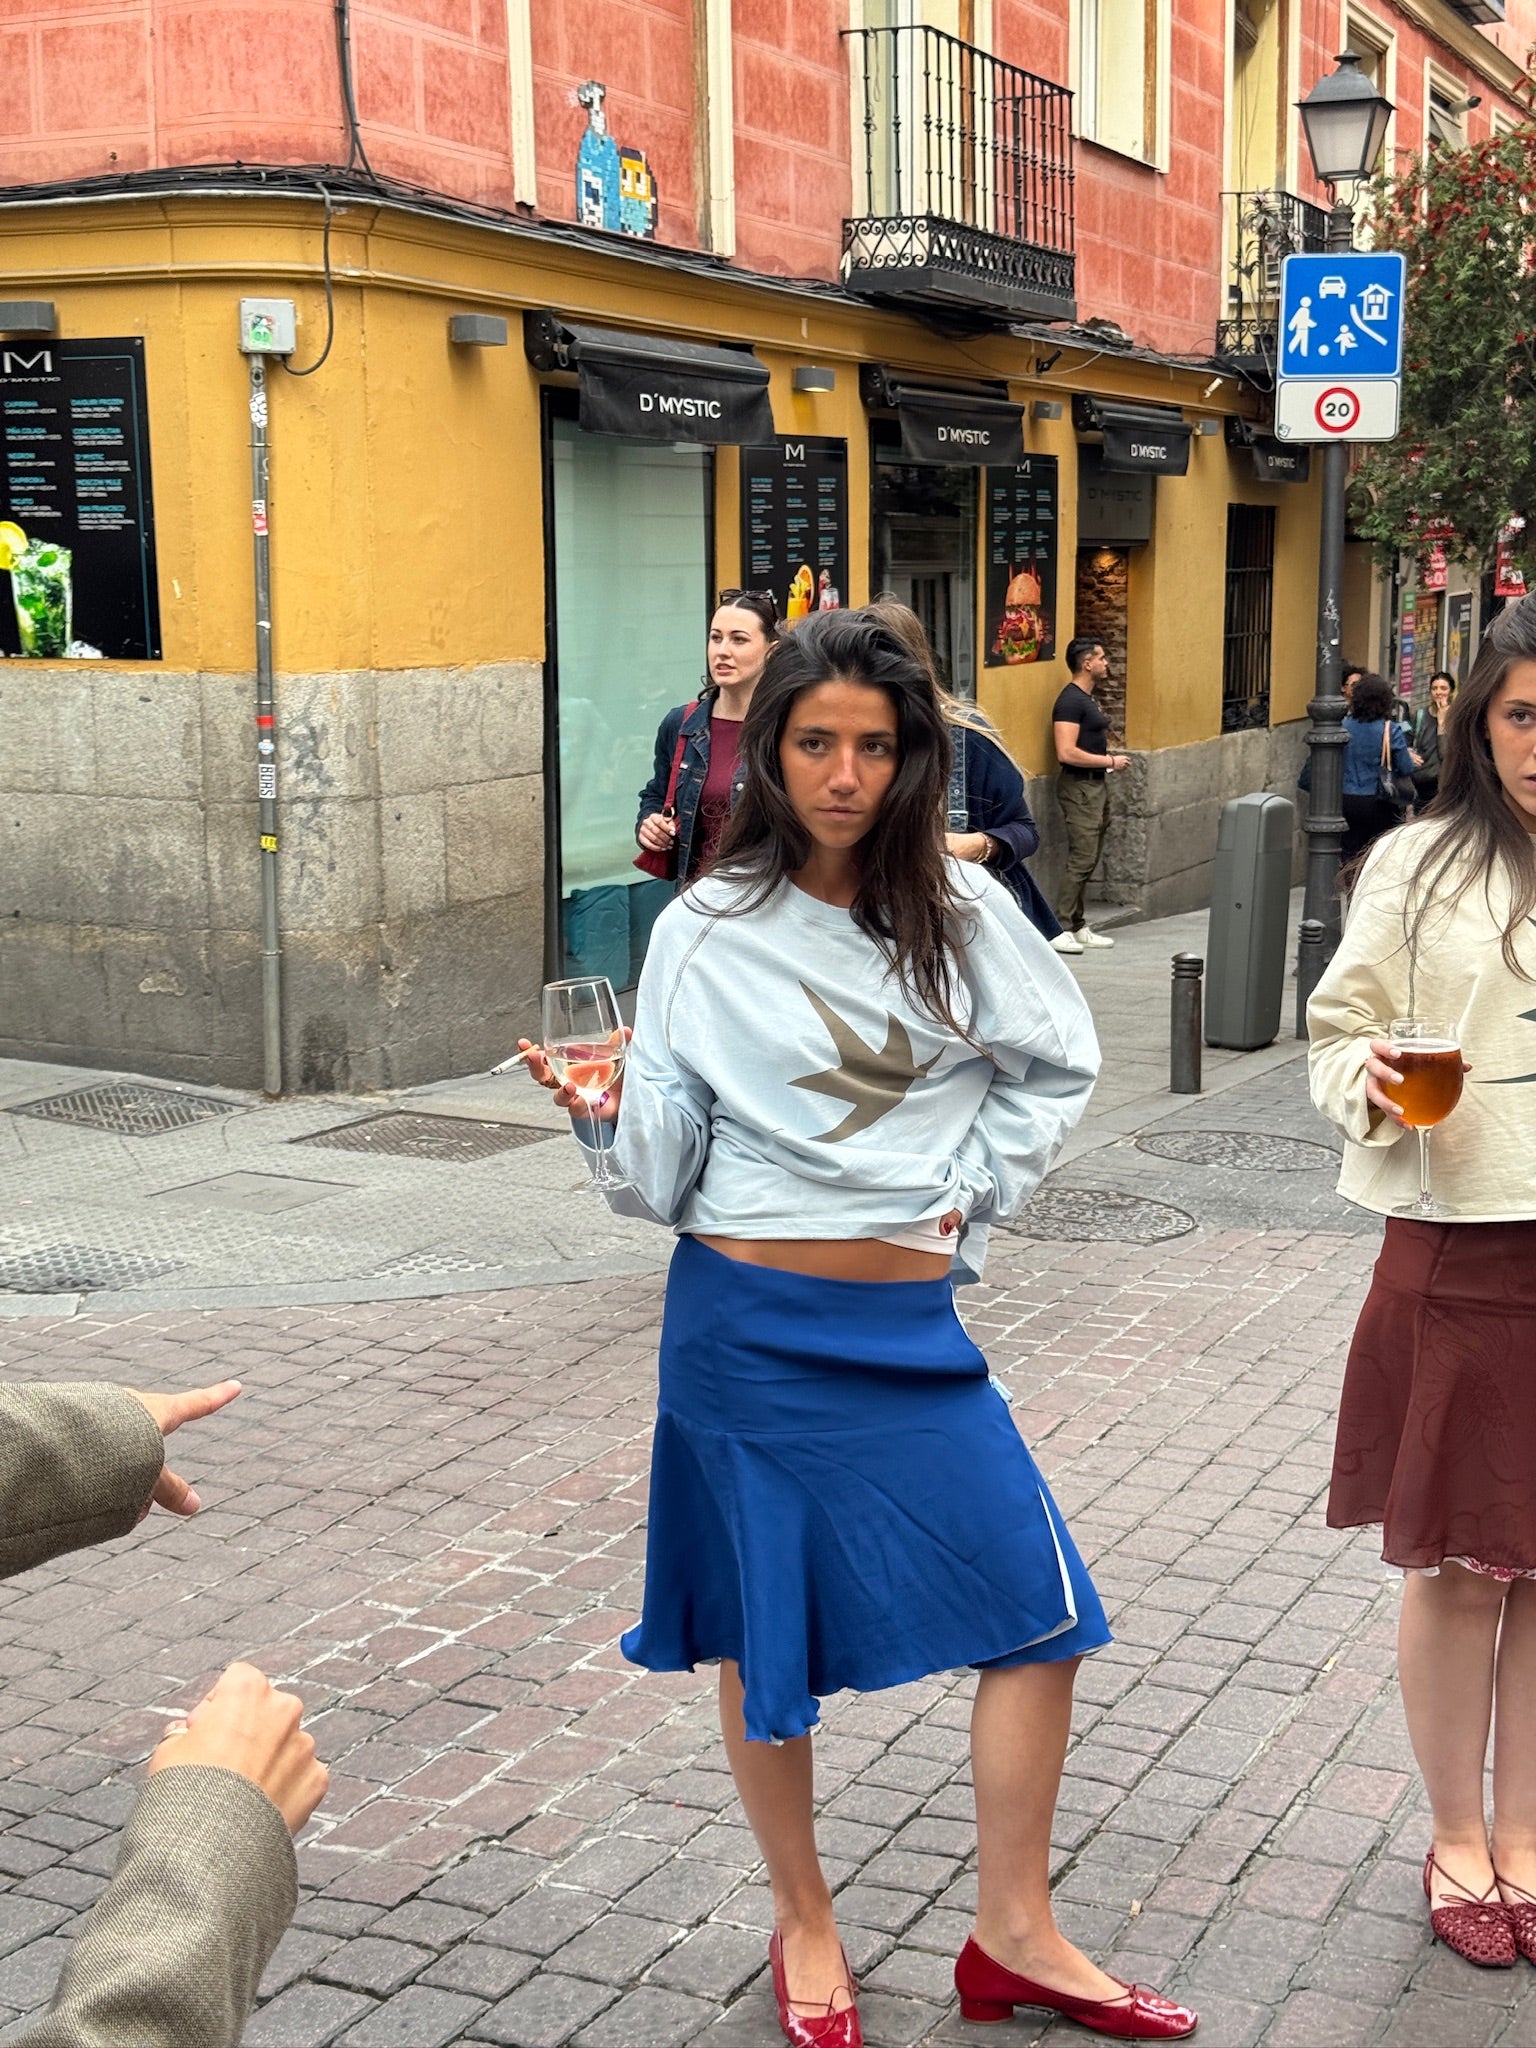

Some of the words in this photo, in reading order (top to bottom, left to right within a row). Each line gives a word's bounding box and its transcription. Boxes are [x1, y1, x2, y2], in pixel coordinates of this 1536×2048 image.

[4, 350, 52, 373] M
[640, 393, 721, 419] D'MYSTIC
[1325, 402, 1350, 417] 20
[937, 426, 990, 445] D'MYSTIC
[785, 443, 805, 461] M
[1130, 444, 1167, 459] D'MYSTIC
